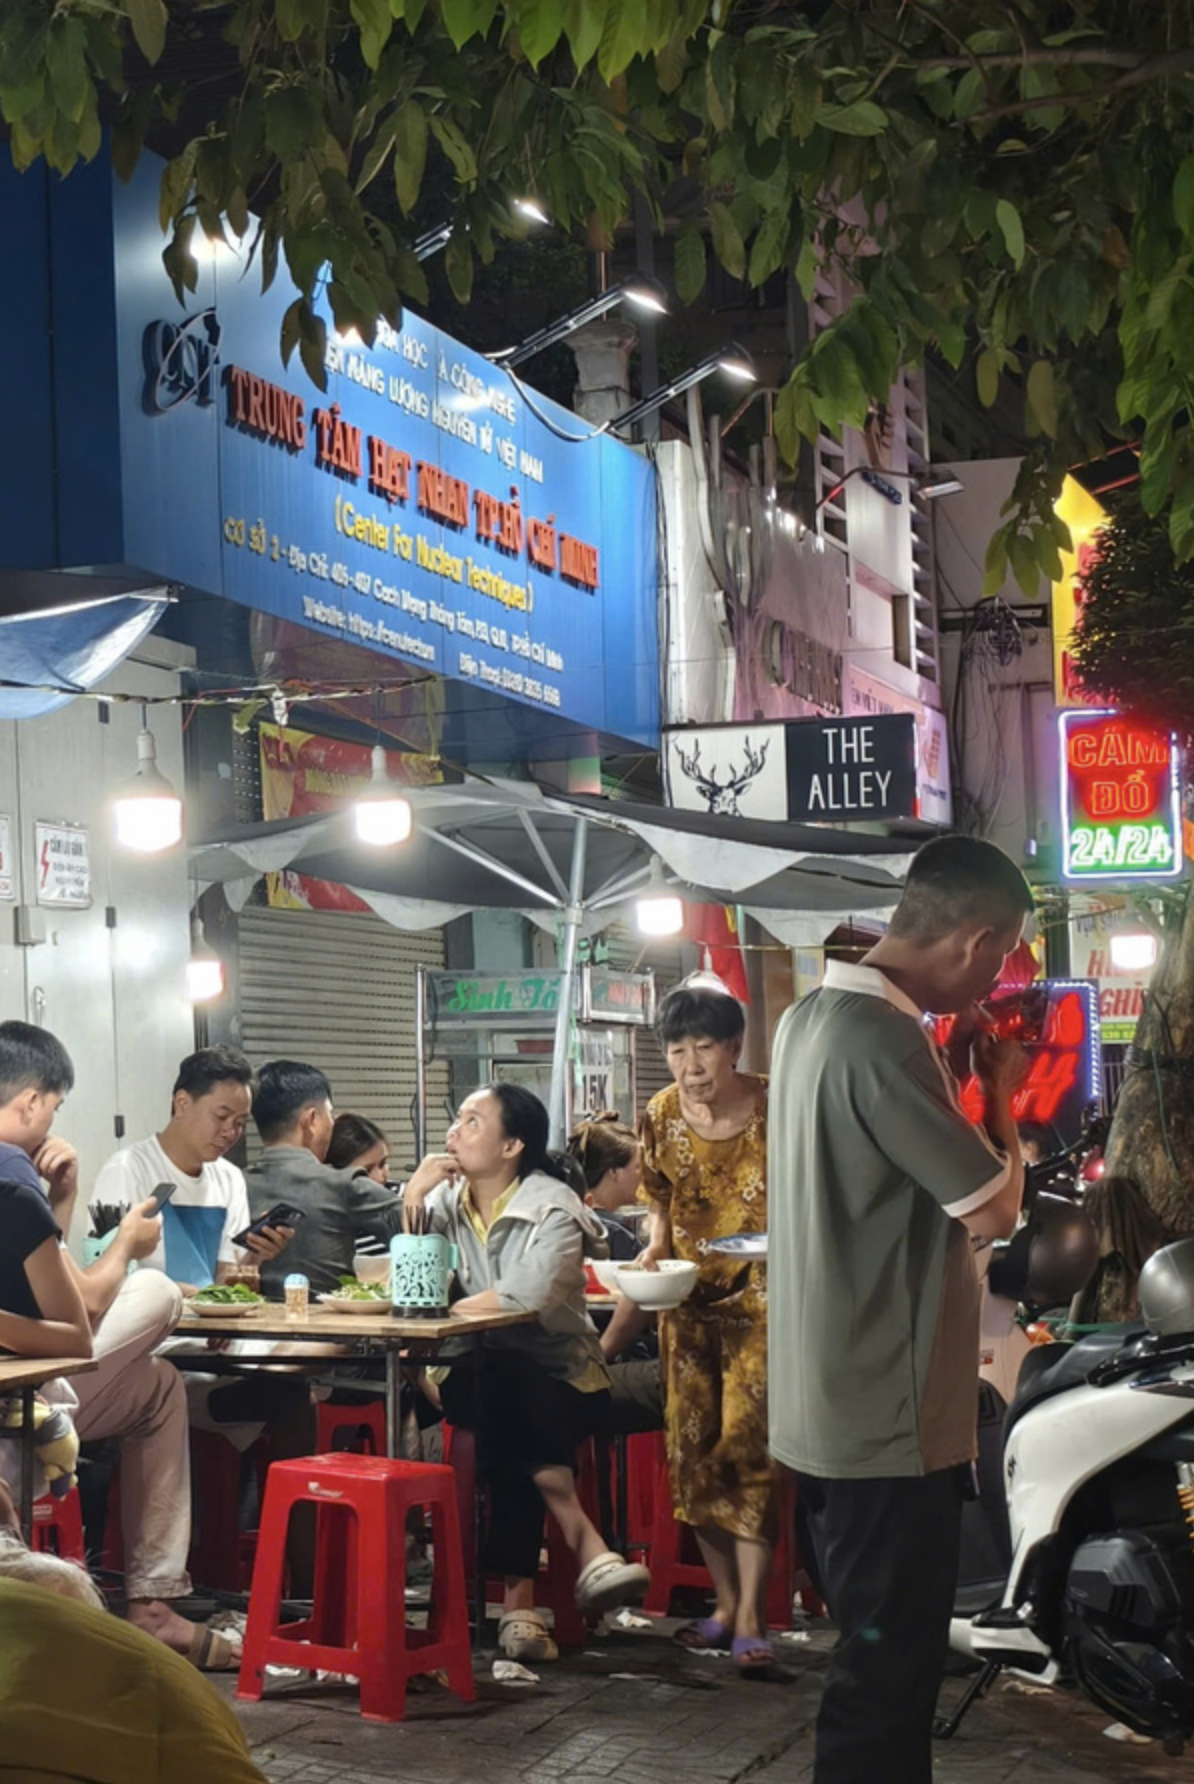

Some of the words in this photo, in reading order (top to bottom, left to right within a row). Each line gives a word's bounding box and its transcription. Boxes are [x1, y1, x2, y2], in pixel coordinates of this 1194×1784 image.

[223, 363, 307, 458] TRUNG
[313, 401, 363, 485] TÂM
[367, 434, 413, 508] HẠT
[558, 530, 601, 592] MINH
[520, 447, 544, 484] NAM
[415, 533, 464, 584] Nuclear
[465, 555, 535, 613] Techniques)
[822, 726, 875, 764] THE
[808, 770, 892, 810] ALLEY
[1070, 825, 1173, 866] 24/24
[447, 980, 514, 1012] Sinh
[582, 1073, 608, 1112] 15K
